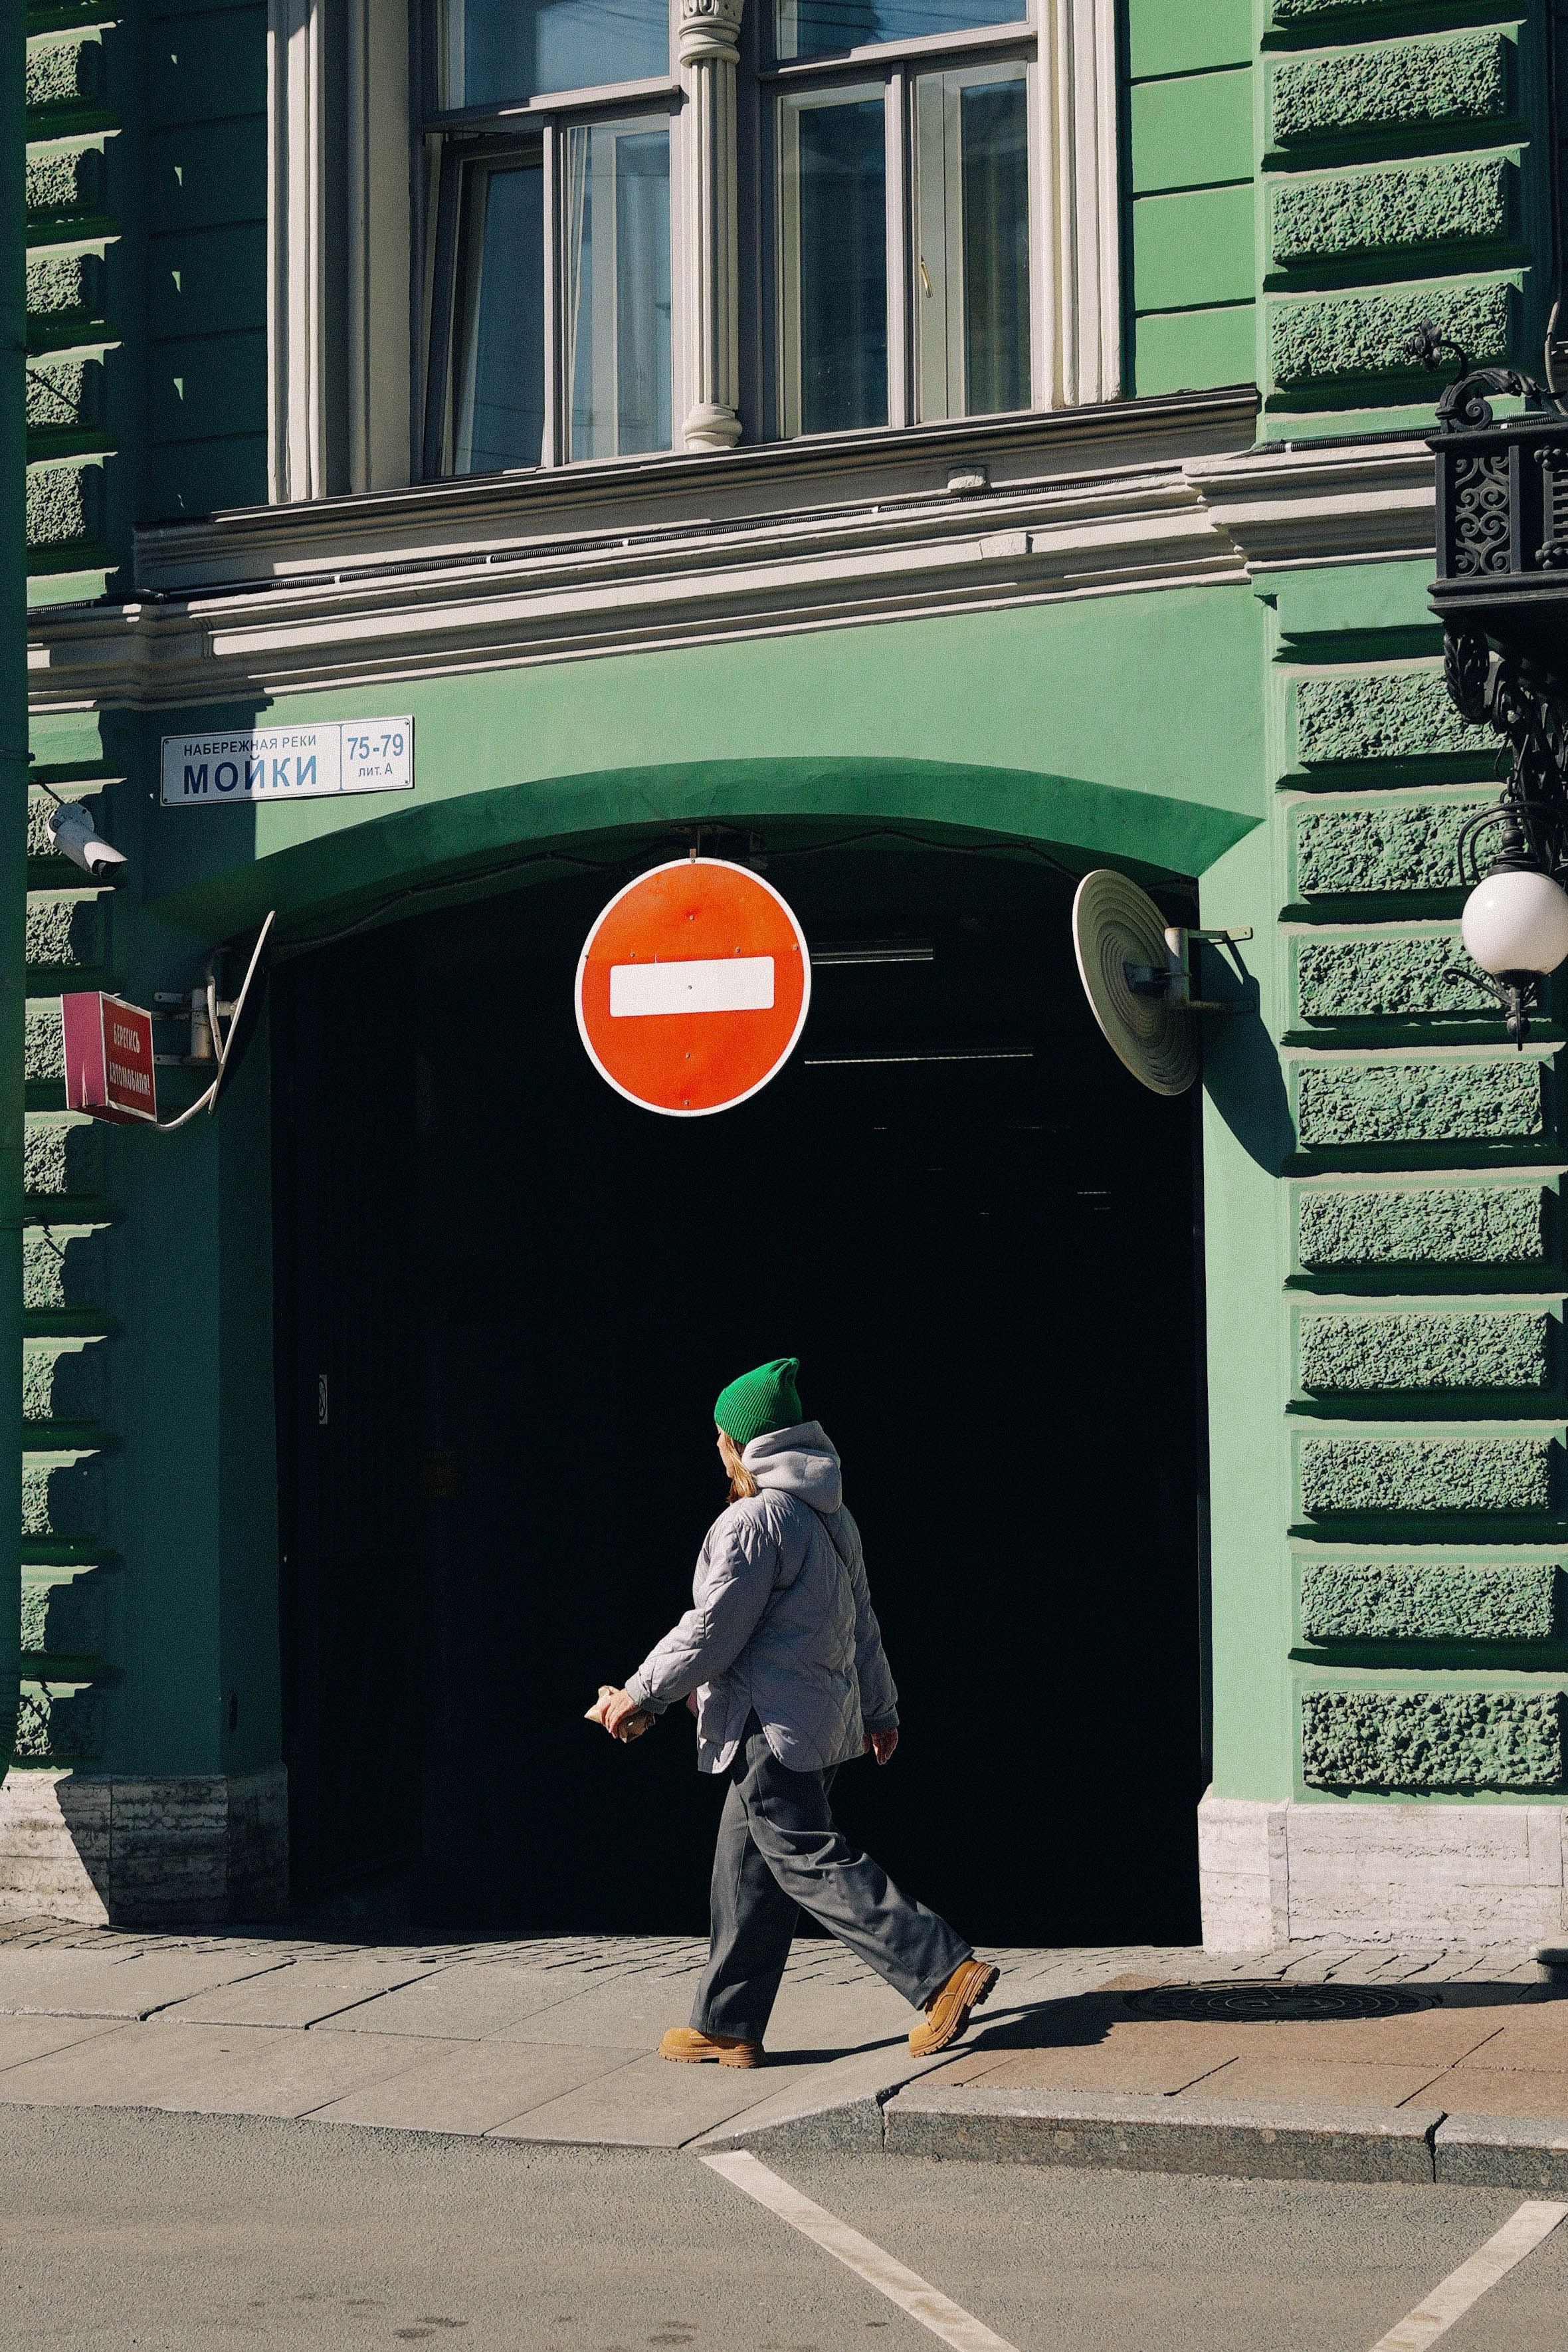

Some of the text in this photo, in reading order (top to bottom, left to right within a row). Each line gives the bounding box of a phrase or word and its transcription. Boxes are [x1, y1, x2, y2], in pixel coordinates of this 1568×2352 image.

[184, 734, 316, 756] НАБЕРЕЖНАЯ РЕКИ
[347, 733, 404, 760] 75-79
[184, 754, 316, 795] МОЙКИ
[385, 762, 393, 774] А
[114, 1022, 140, 1053] БЕРЕГИСЬ
[110, 1061, 150, 1096] АВТОМОБИЛЯ!
